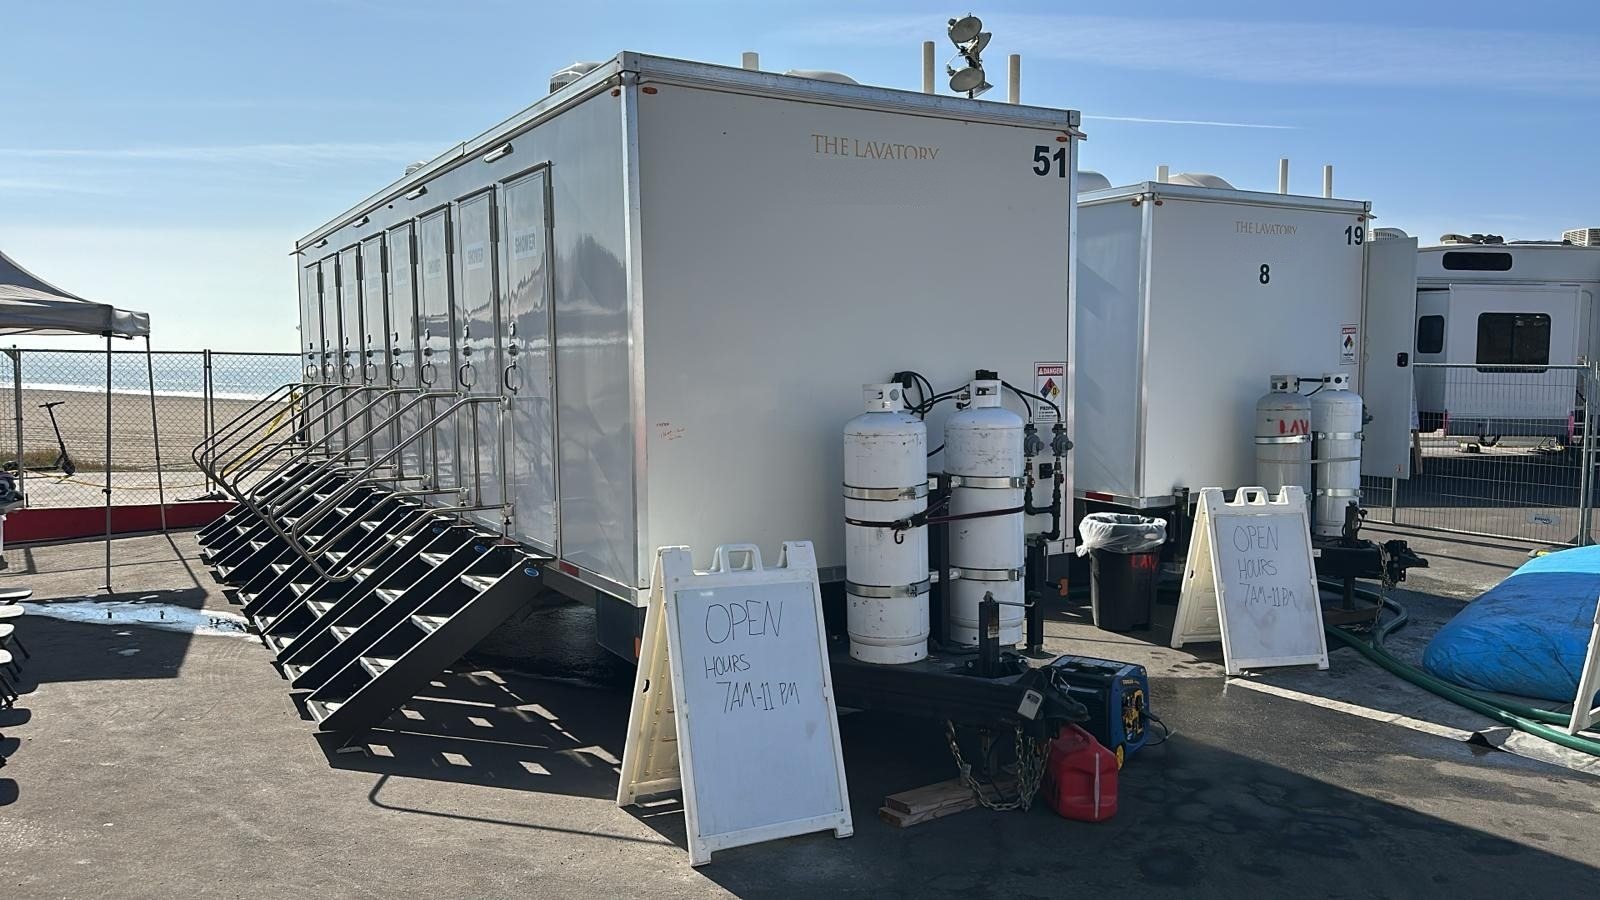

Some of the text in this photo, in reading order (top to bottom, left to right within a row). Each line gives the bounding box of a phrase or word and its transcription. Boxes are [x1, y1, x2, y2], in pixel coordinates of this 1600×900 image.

[811, 134, 940, 160] THE LAVATORY
[1033, 145, 1066, 178] 51
[1235, 221, 1297, 235] THE LAVATORY
[1344, 225, 1364, 246] 19
[514, 232, 536, 255] SHOWER
[1259, 263, 1270, 284] 8
[1043, 367, 1063, 375] DANGER
[1279, 418, 1309, 435] LAV
[1233, 525, 1279, 553] OPEN
[1238, 557, 1278, 579] HOURS
[705, 599, 784, 644] OPEN
[703, 653, 751, 679] HOURS
